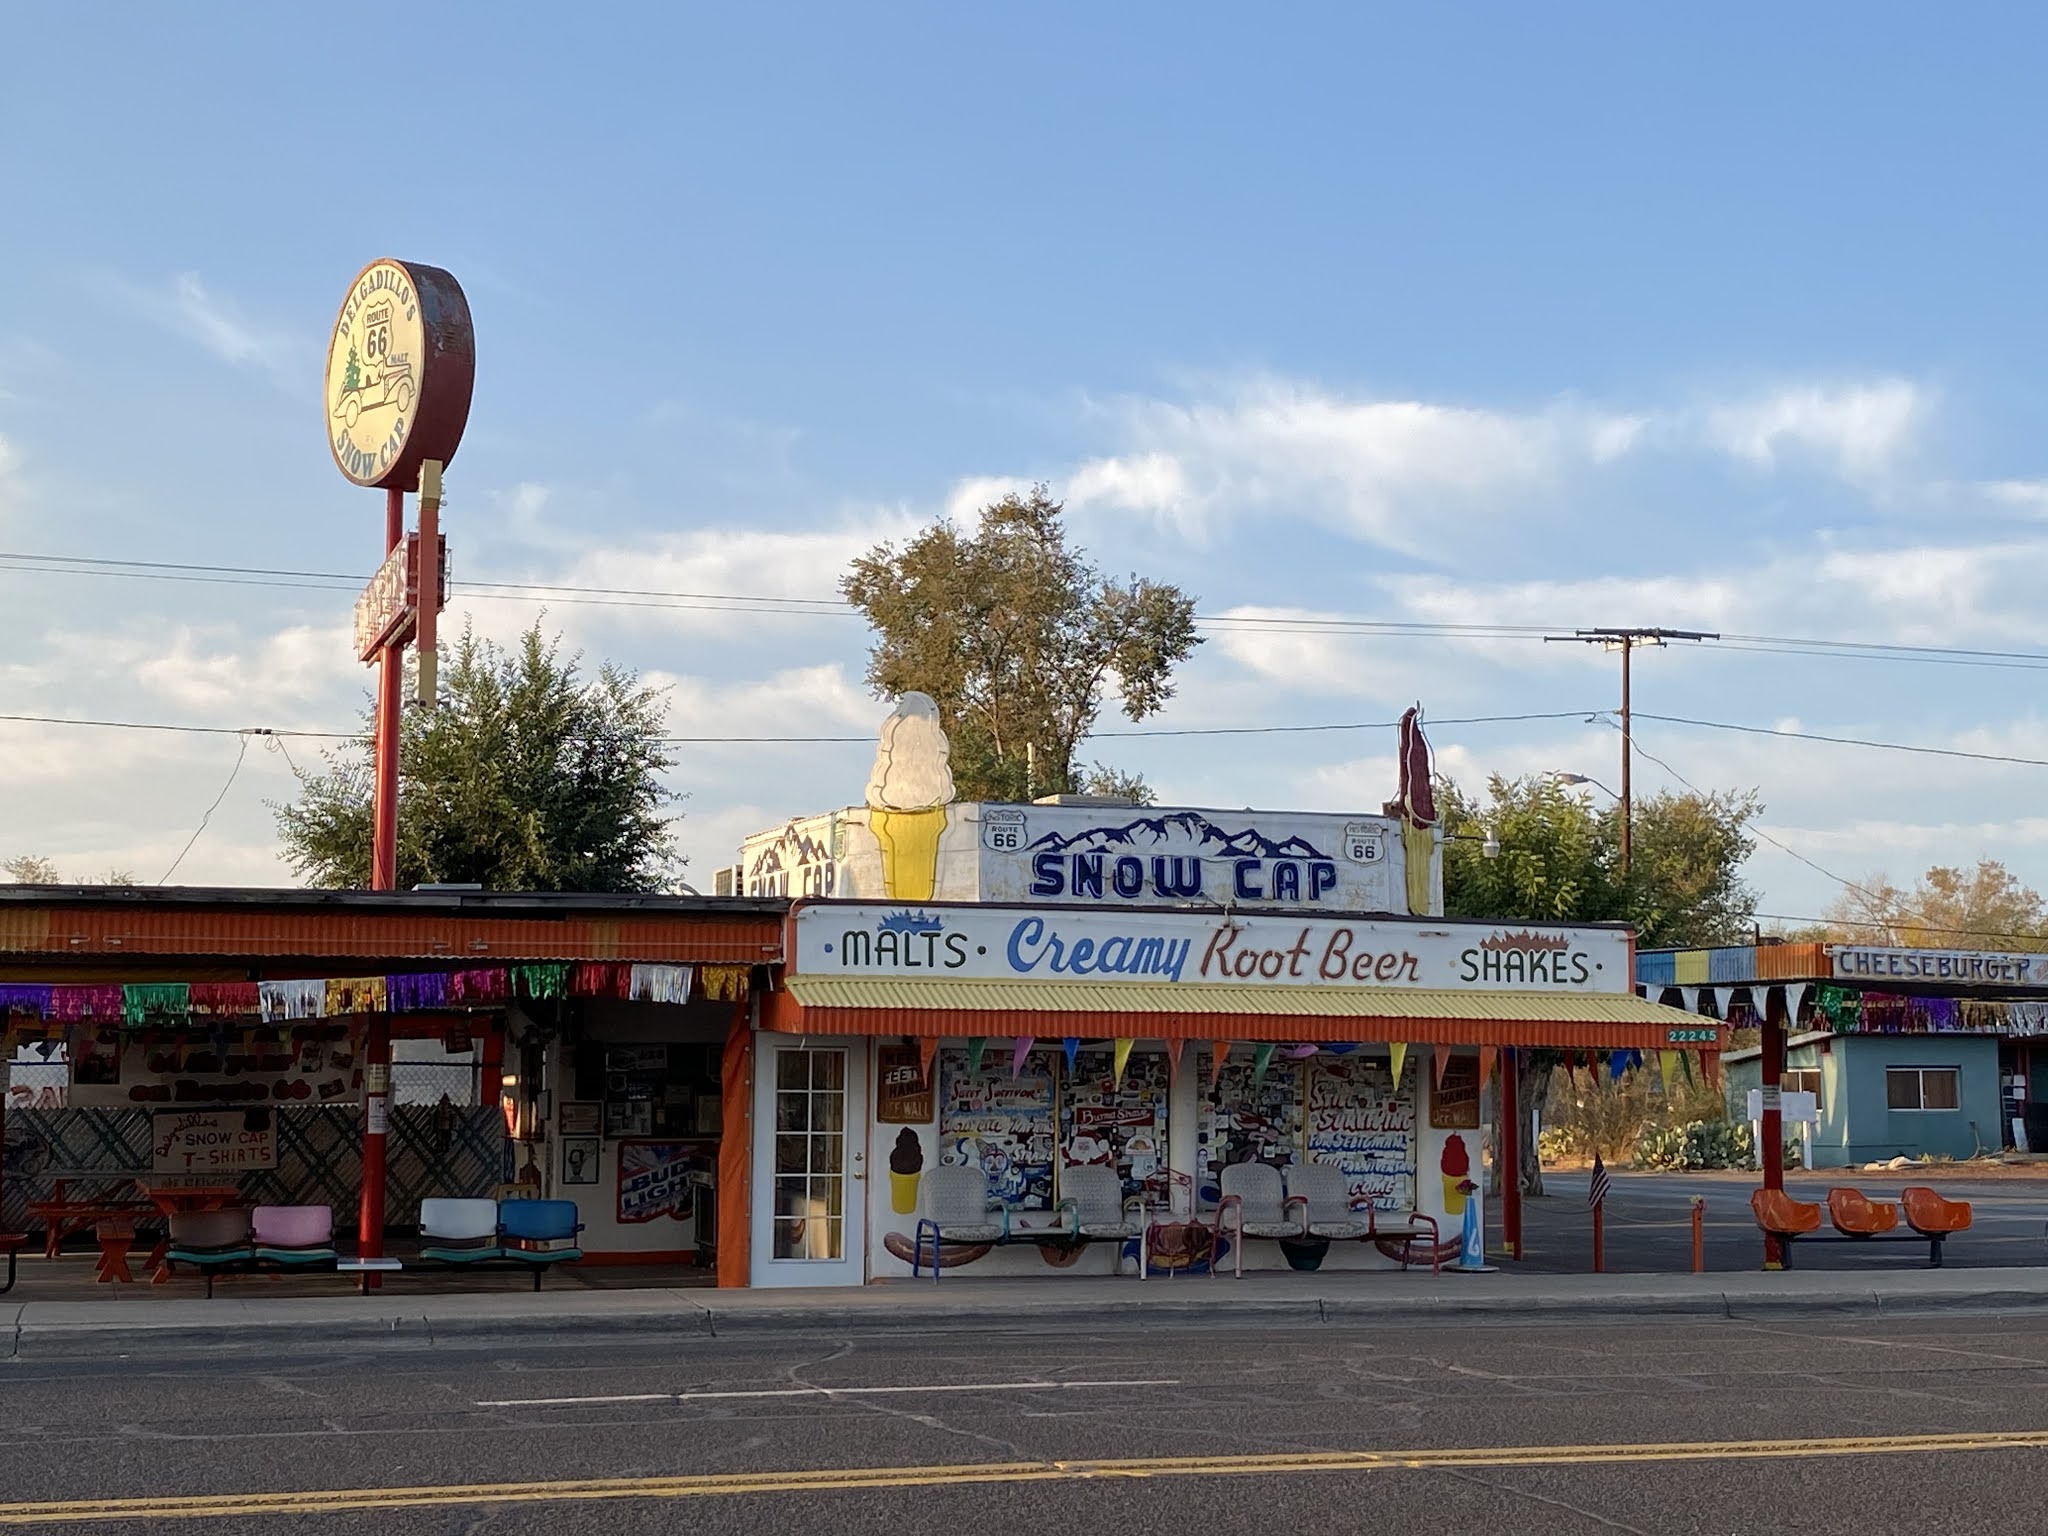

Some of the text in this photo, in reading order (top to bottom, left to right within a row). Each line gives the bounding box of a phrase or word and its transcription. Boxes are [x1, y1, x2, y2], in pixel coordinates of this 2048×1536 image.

[340, 269, 416, 338] DELGADILLO'S
[366, 307, 390, 324] ROUTE
[367, 326, 387, 358] 66
[391, 353, 408, 364] MALT
[336, 417, 406, 479] SNOW CAP
[992, 825, 1019, 833] ROUTE
[994, 833, 1017, 847] 66
[1351, 838, 1376, 846] ROUTE
[1354, 845, 1375, 859] 66
[1029, 852, 1338, 901] SNOW CAP
[842, 916, 1589, 984] MALTS Creamy Root Beer SHAKES
[1840, 951, 2030, 984] CHEESEBURGER
[1668, 1029, 1718, 1043] 22245
[185, 1131, 268, 1146] SNOW CAP
[631, 1160, 694, 1192] BUD
[624, 1174, 692, 1210] LIGH
